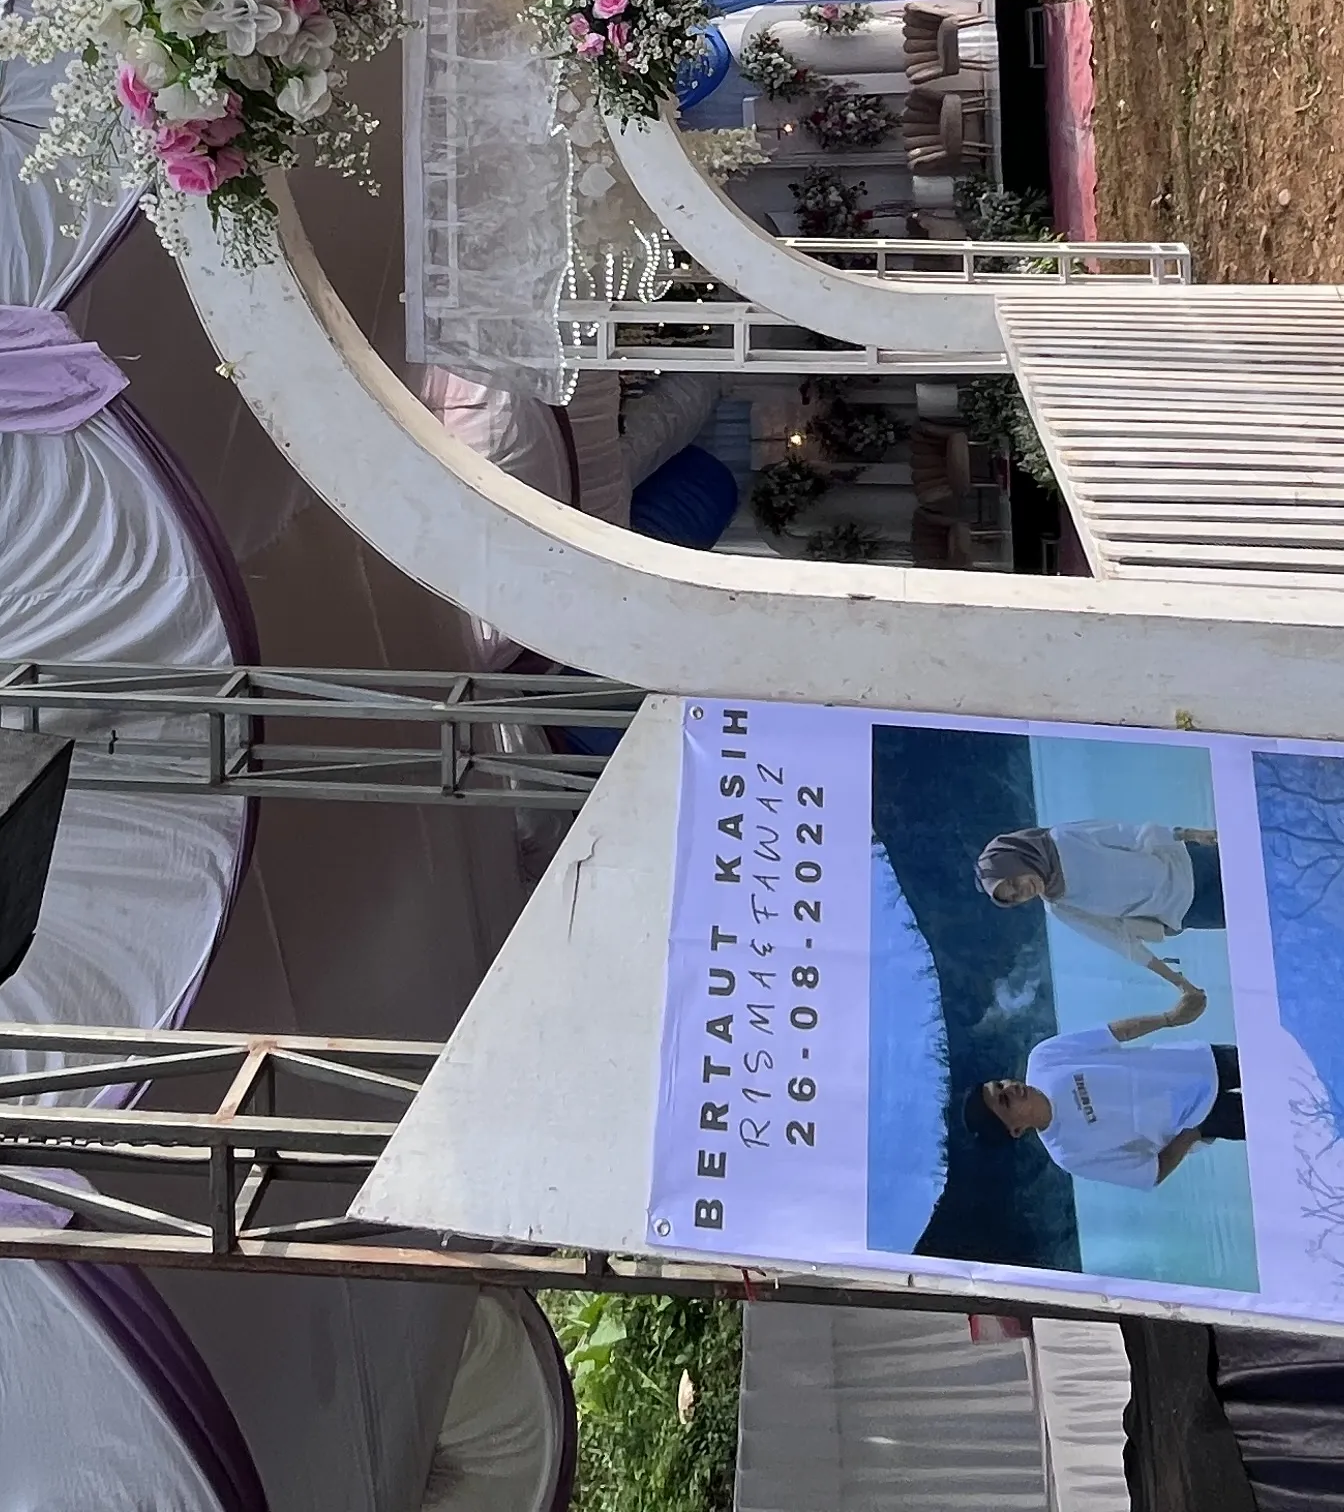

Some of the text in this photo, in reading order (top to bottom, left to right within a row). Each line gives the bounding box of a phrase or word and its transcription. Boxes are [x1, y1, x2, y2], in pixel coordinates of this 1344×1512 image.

[694, 709, 749, 1230] BERTAUT KASIH
[786, 784, 824, 1147] 26-08-2022
